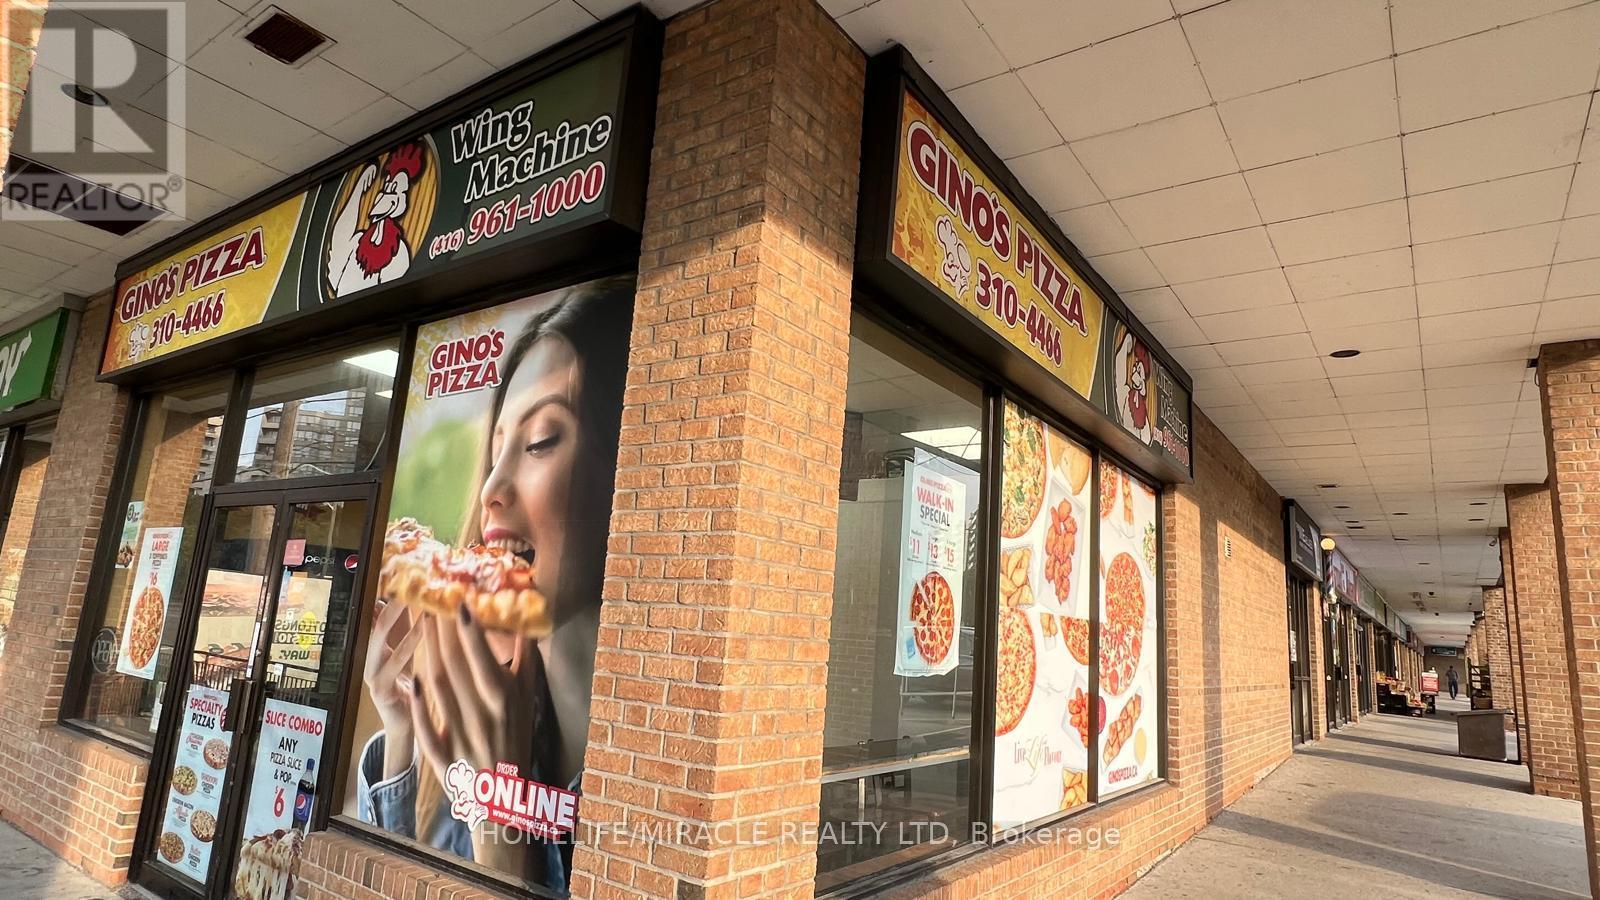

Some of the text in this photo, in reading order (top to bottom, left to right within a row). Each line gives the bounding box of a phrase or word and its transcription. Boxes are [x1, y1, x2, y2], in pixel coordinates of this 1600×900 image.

[450, 100, 535, 165] Wing
[463, 115, 613, 204] Machine
[428, 160, 606, 260] (416) 961-1000
[907, 120, 1089, 337] GINO'S PIZZA
[119, 229, 265, 323] GINO'S PIZZA
[149, 290, 225, 350] 310-4466
[975, 258, 1064, 368] 310-4466
[430, 329, 505, 370] GINO'S
[426, 361, 502, 399] PIZZA
[916, 486, 954, 513] WALK-IN
[919, 504, 950, 527] SPECIAL
[190, 697, 223, 717] SPECIALTY
[191, 712, 216, 730] PIZZAS
[265, 710, 323, 736] SLICE COMBO
[278, 736, 298, 753] ANY
[270, 752, 302, 771] PIZZA SLICE
[279, 771, 292, 783] POP
[496, 762, 519, 777] ORDER
[474, 771, 577, 829] ONLINE
[492, 808, 559, 835] www.ginospizza.ca
